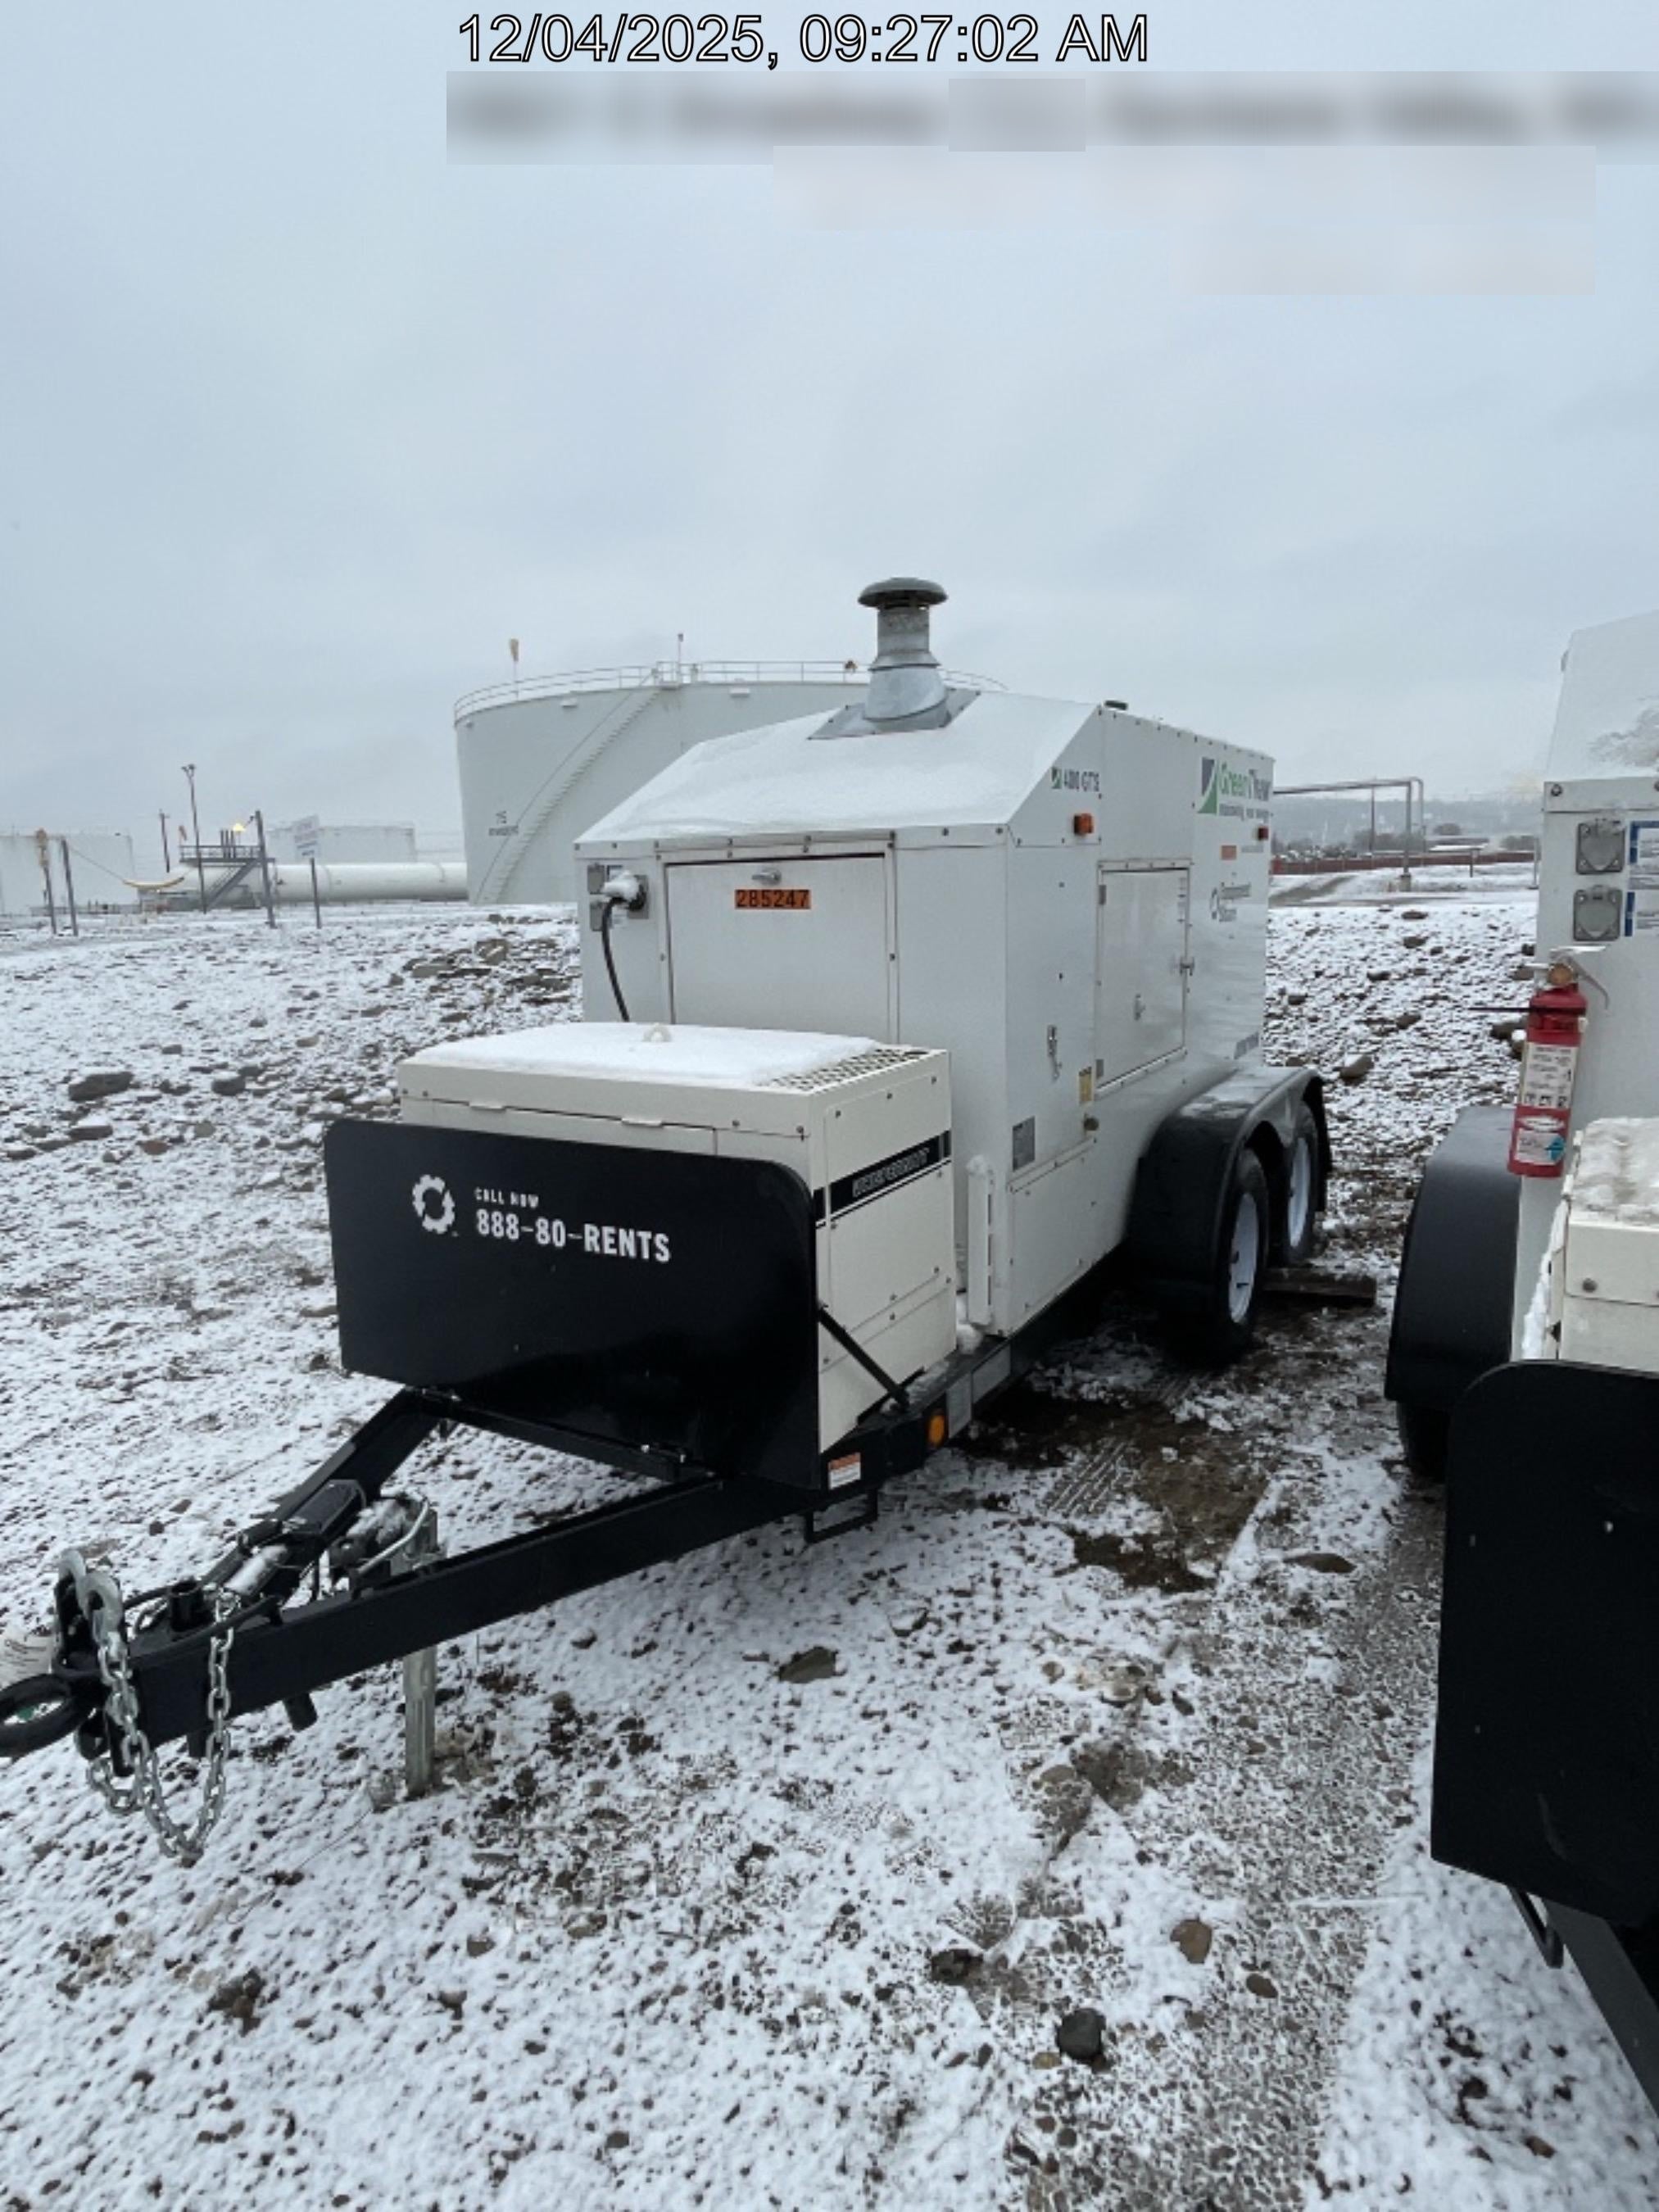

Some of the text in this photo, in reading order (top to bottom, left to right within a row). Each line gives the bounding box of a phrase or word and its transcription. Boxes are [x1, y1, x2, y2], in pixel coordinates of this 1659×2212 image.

[736, 889, 810, 908] 285247
[474, 1186, 540, 1209] CALL NOW
[476, 1208, 671, 1263] 888-80-RENTS
